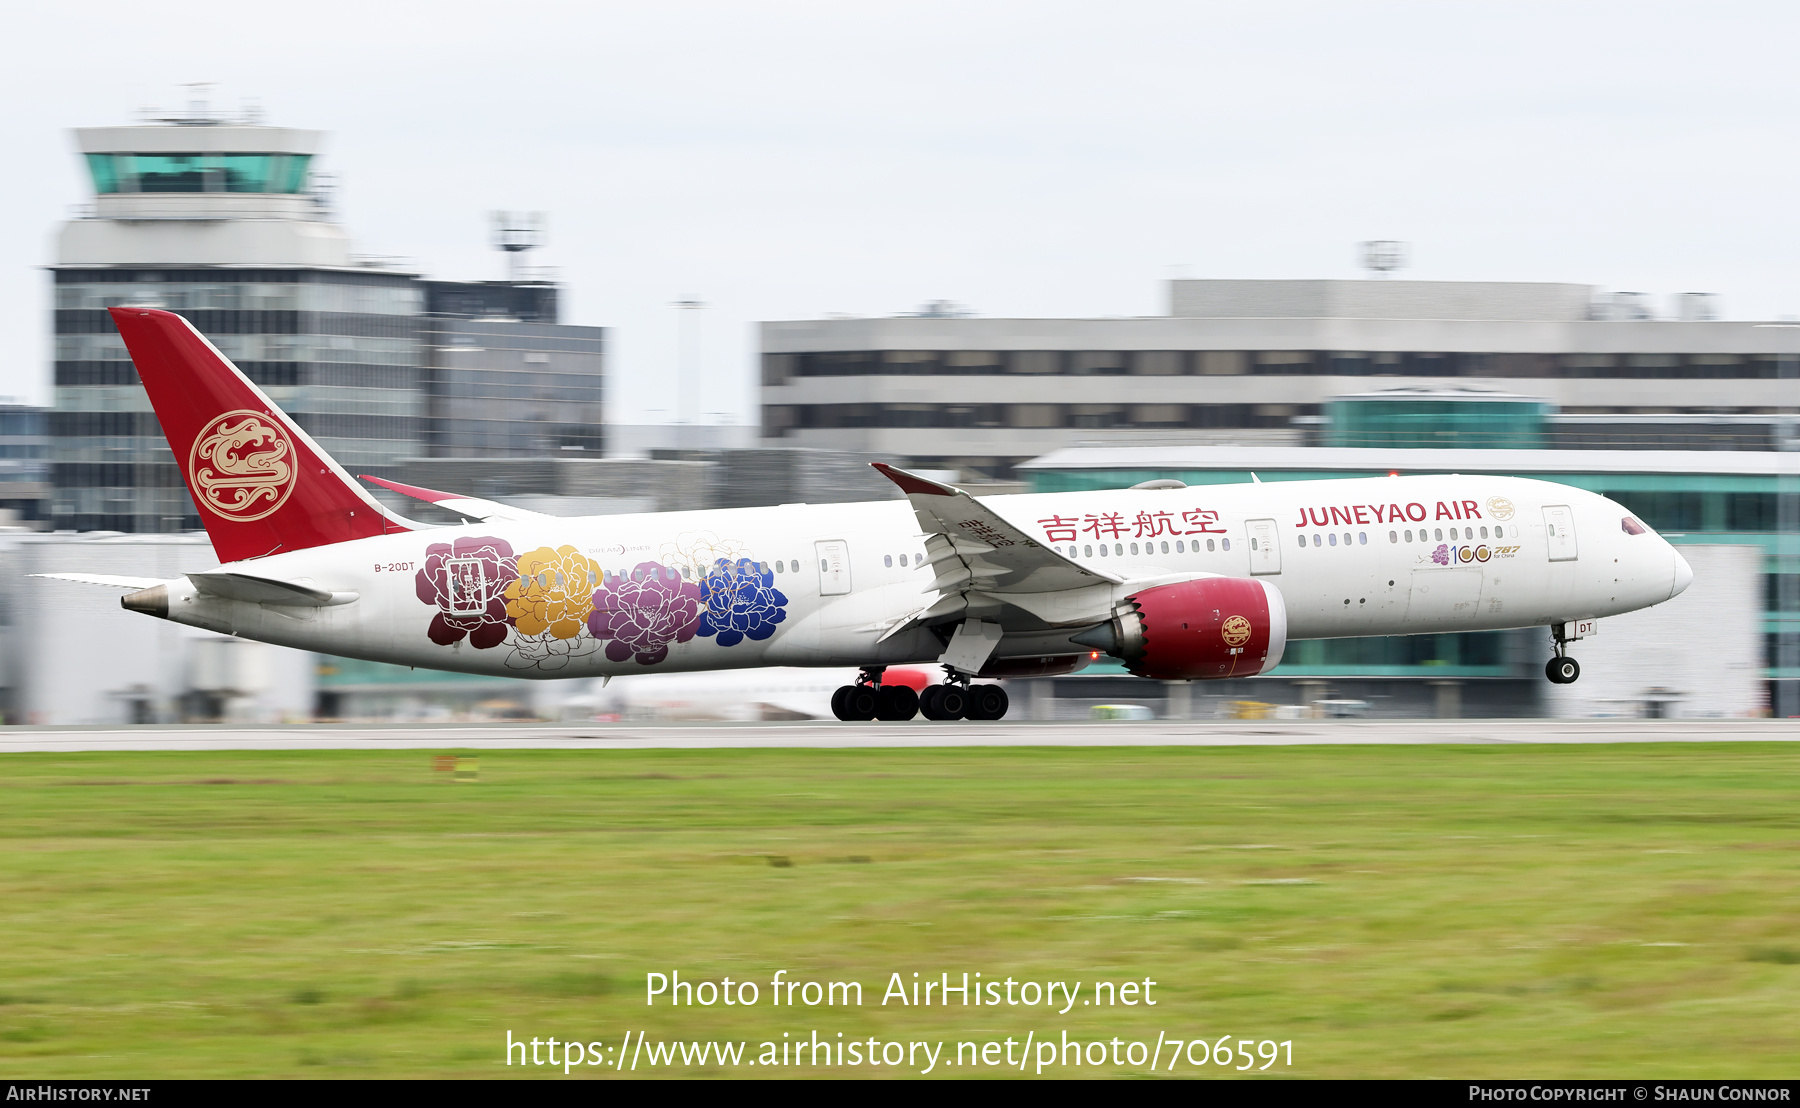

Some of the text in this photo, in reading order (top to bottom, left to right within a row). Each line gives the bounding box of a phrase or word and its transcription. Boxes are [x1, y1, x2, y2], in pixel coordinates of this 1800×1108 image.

[1295, 500, 1483, 528] JUNEYAO AIR
[1037, 507, 1228, 543] 吉祥航空
[1494, 545, 1521, 554] 787
[374, 561, 415, 574] B-20DT
[1580, 622, 1593, 633] DT
